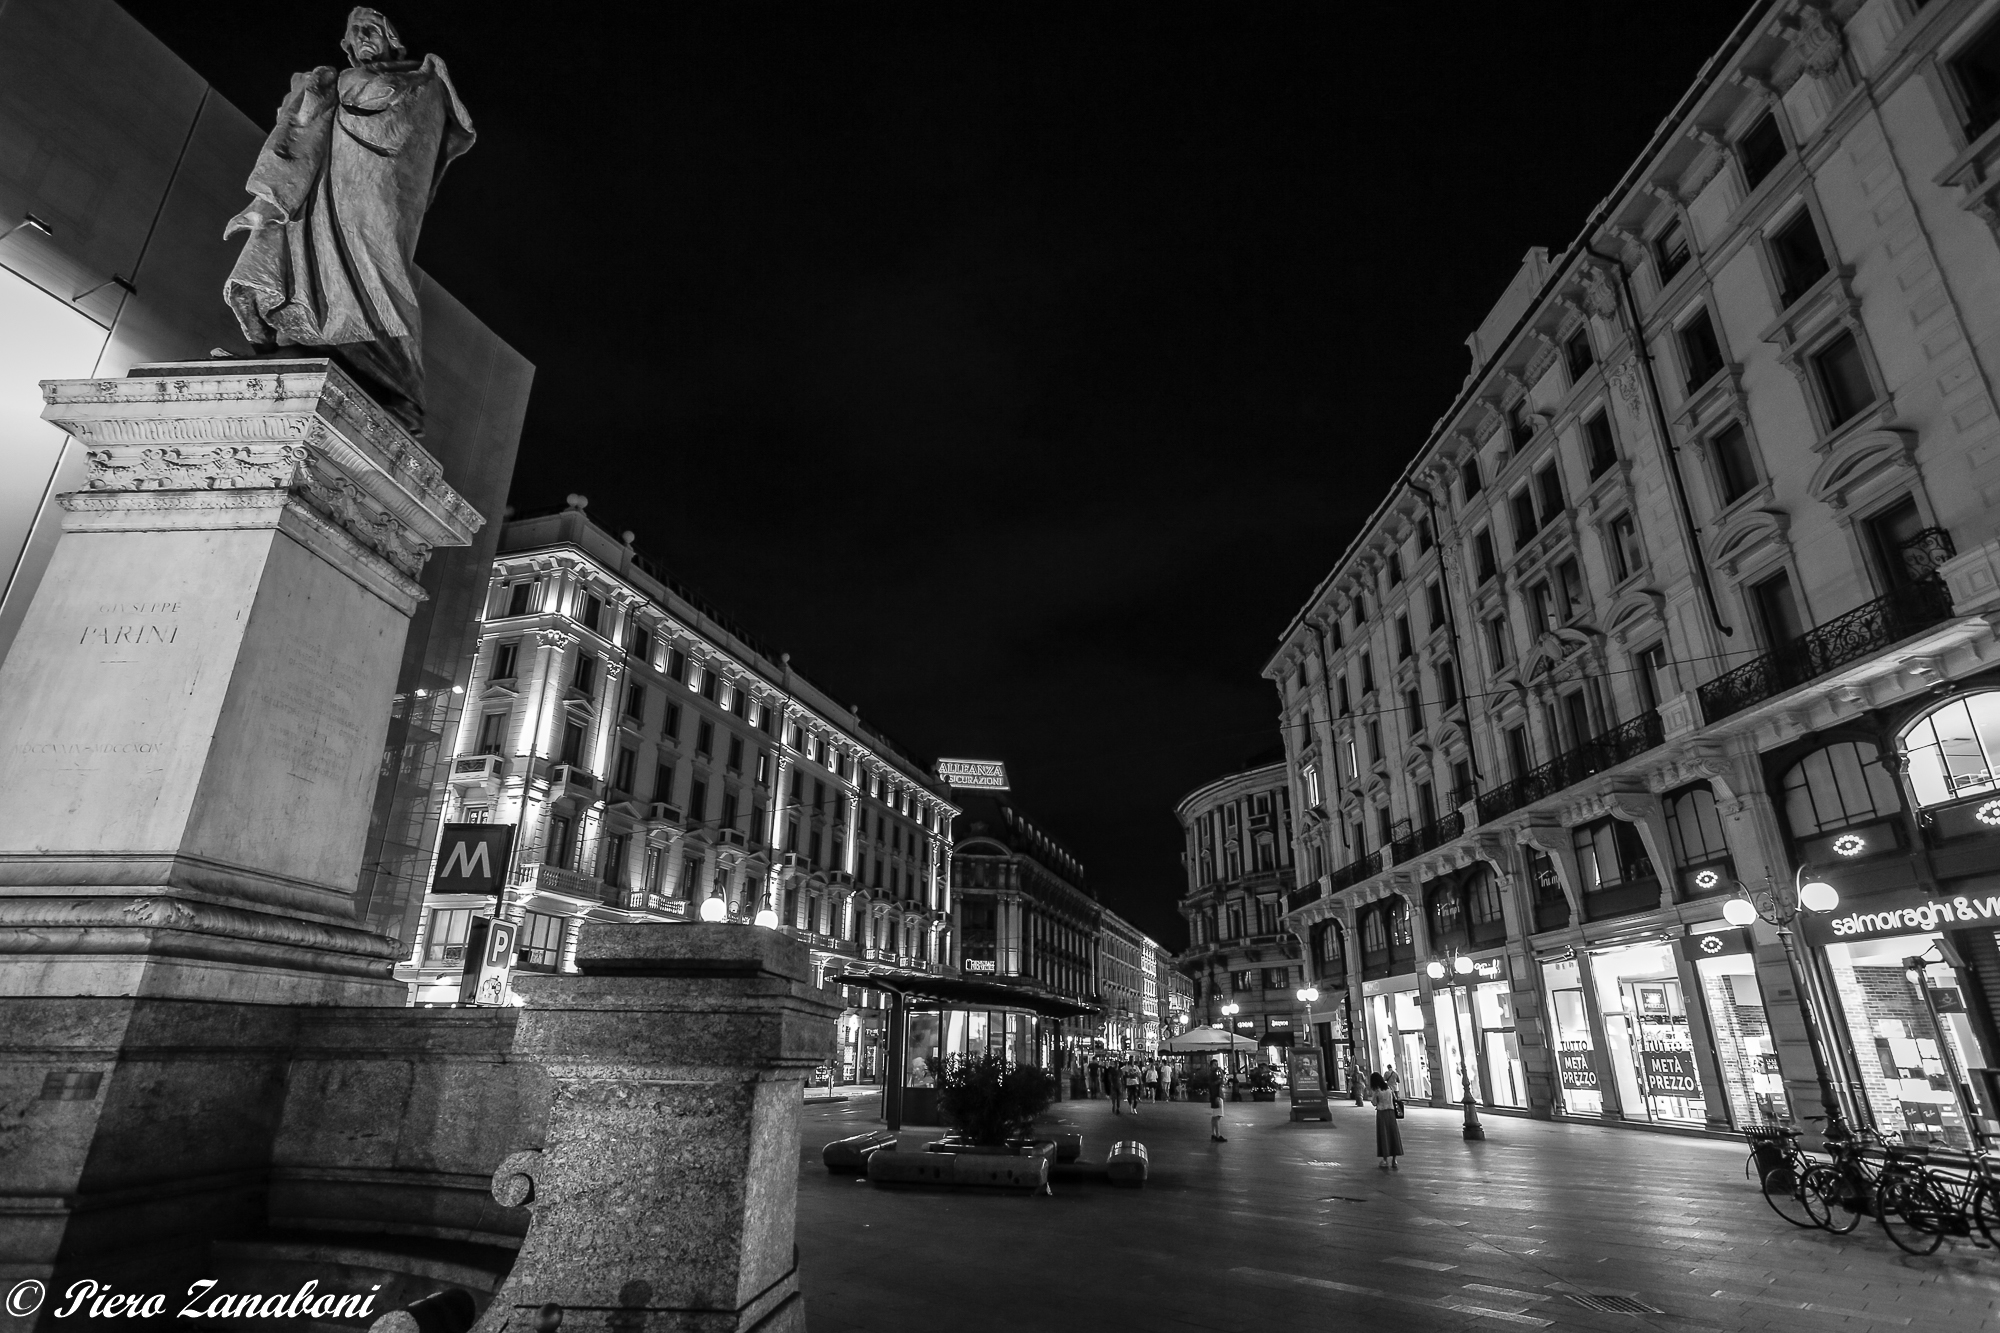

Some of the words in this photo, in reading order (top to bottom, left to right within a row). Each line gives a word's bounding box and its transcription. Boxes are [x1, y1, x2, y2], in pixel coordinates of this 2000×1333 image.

[79, 624, 179, 645] PARINI
[938, 763, 1003, 776] ALLEANZA
[440, 841, 491, 878] M
[1832, 901, 1954, 935] salmoiraghi
[1953, 896, 1978, 921] &
[491, 929, 509, 962] P
[1560, 1040, 1588, 1052] TUTTO
[1564, 1054, 1588, 1069] METÀ
[1651, 1056, 1683, 1073] METÀ
[1562, 1071, 1596, 1085] PREZZO
[1648, 1075, 1695, 1091] PREZZO
